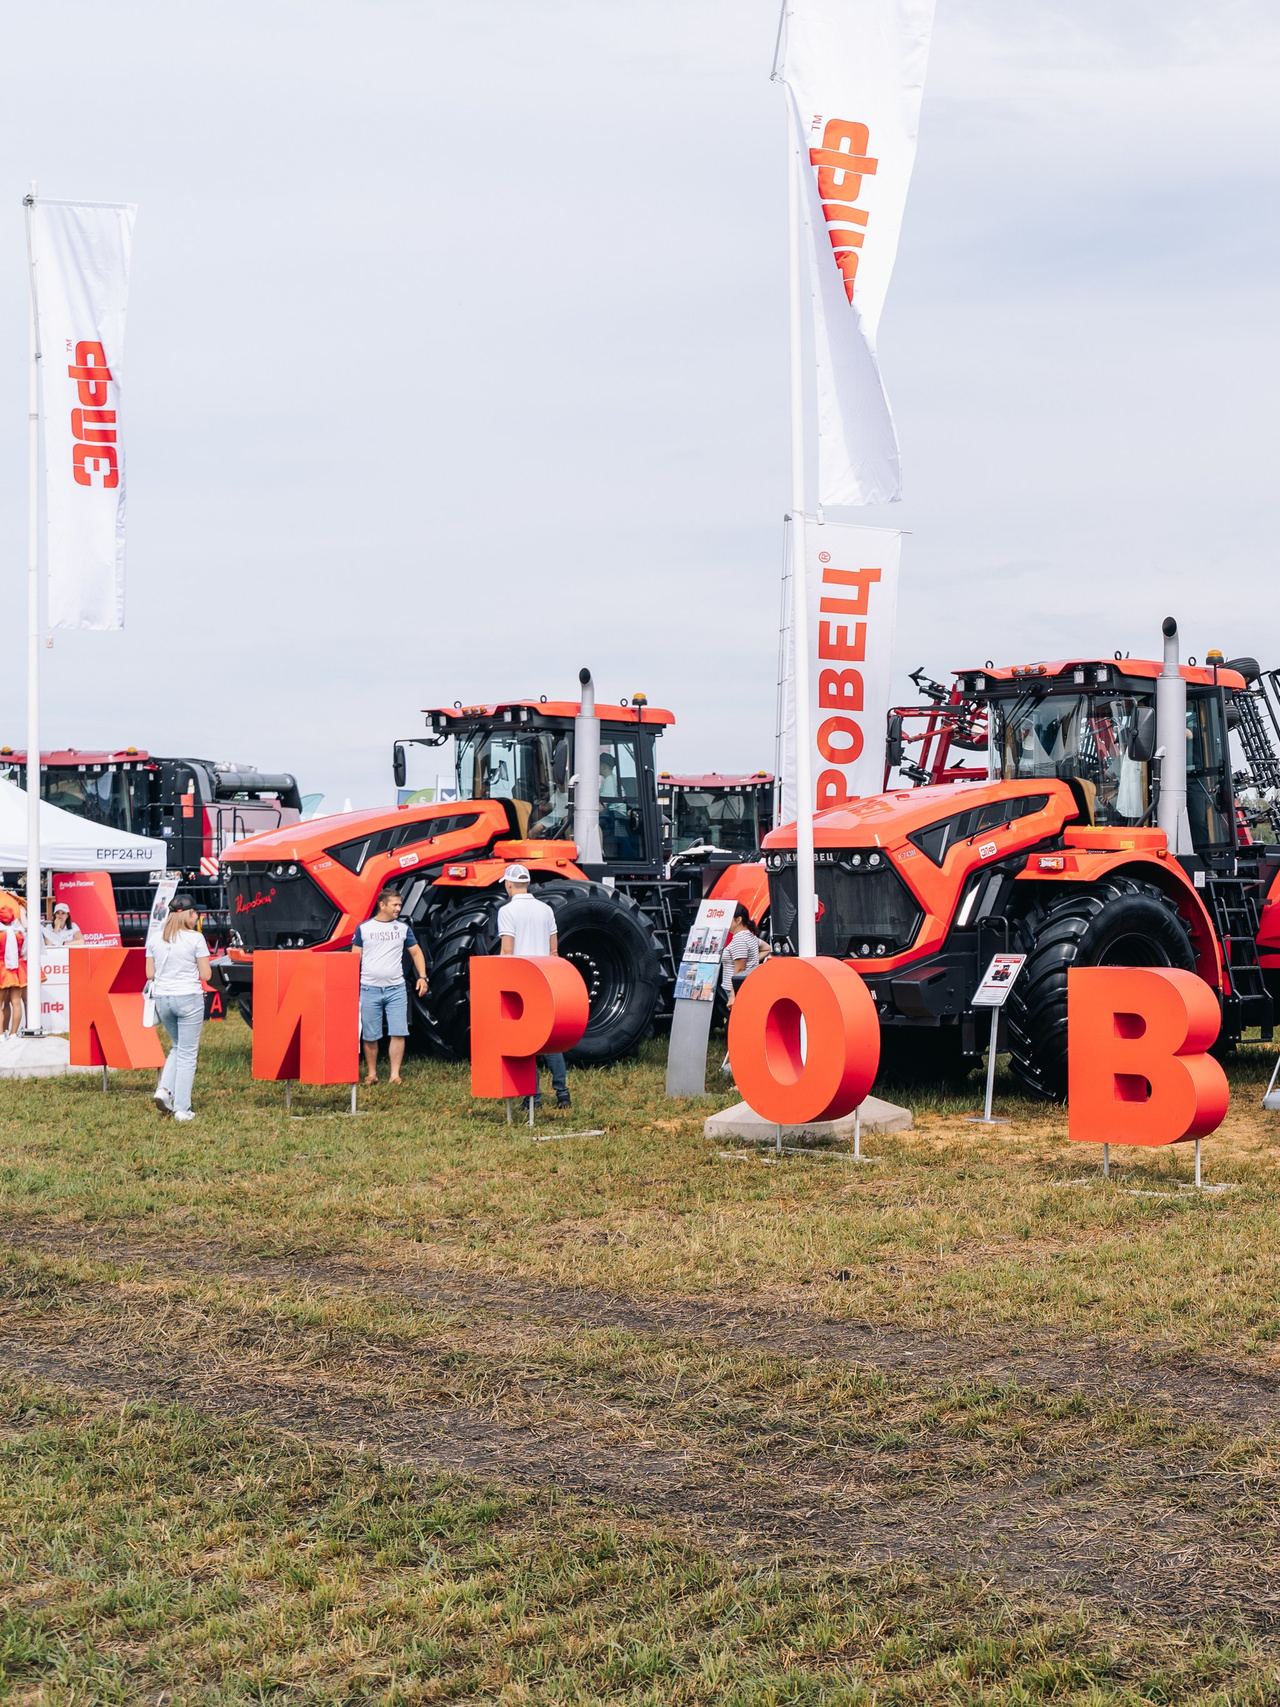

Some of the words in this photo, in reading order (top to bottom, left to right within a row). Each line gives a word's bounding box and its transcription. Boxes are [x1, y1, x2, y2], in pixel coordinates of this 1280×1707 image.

[809, 119, 878, 304] ПФ
[816, 567, 882, 809] РОВЕЦ
[96, 849, 153, 860] EPF24.RU
[786, 852, 834, 862] КИВЕЦ
[83, 933, 104, 941] БОДА
[369, 931, 401, 941] RUSSIA
[41, 965, 70, 975] ОВЕ
[41, 1002, 64, 1013] ПФ
